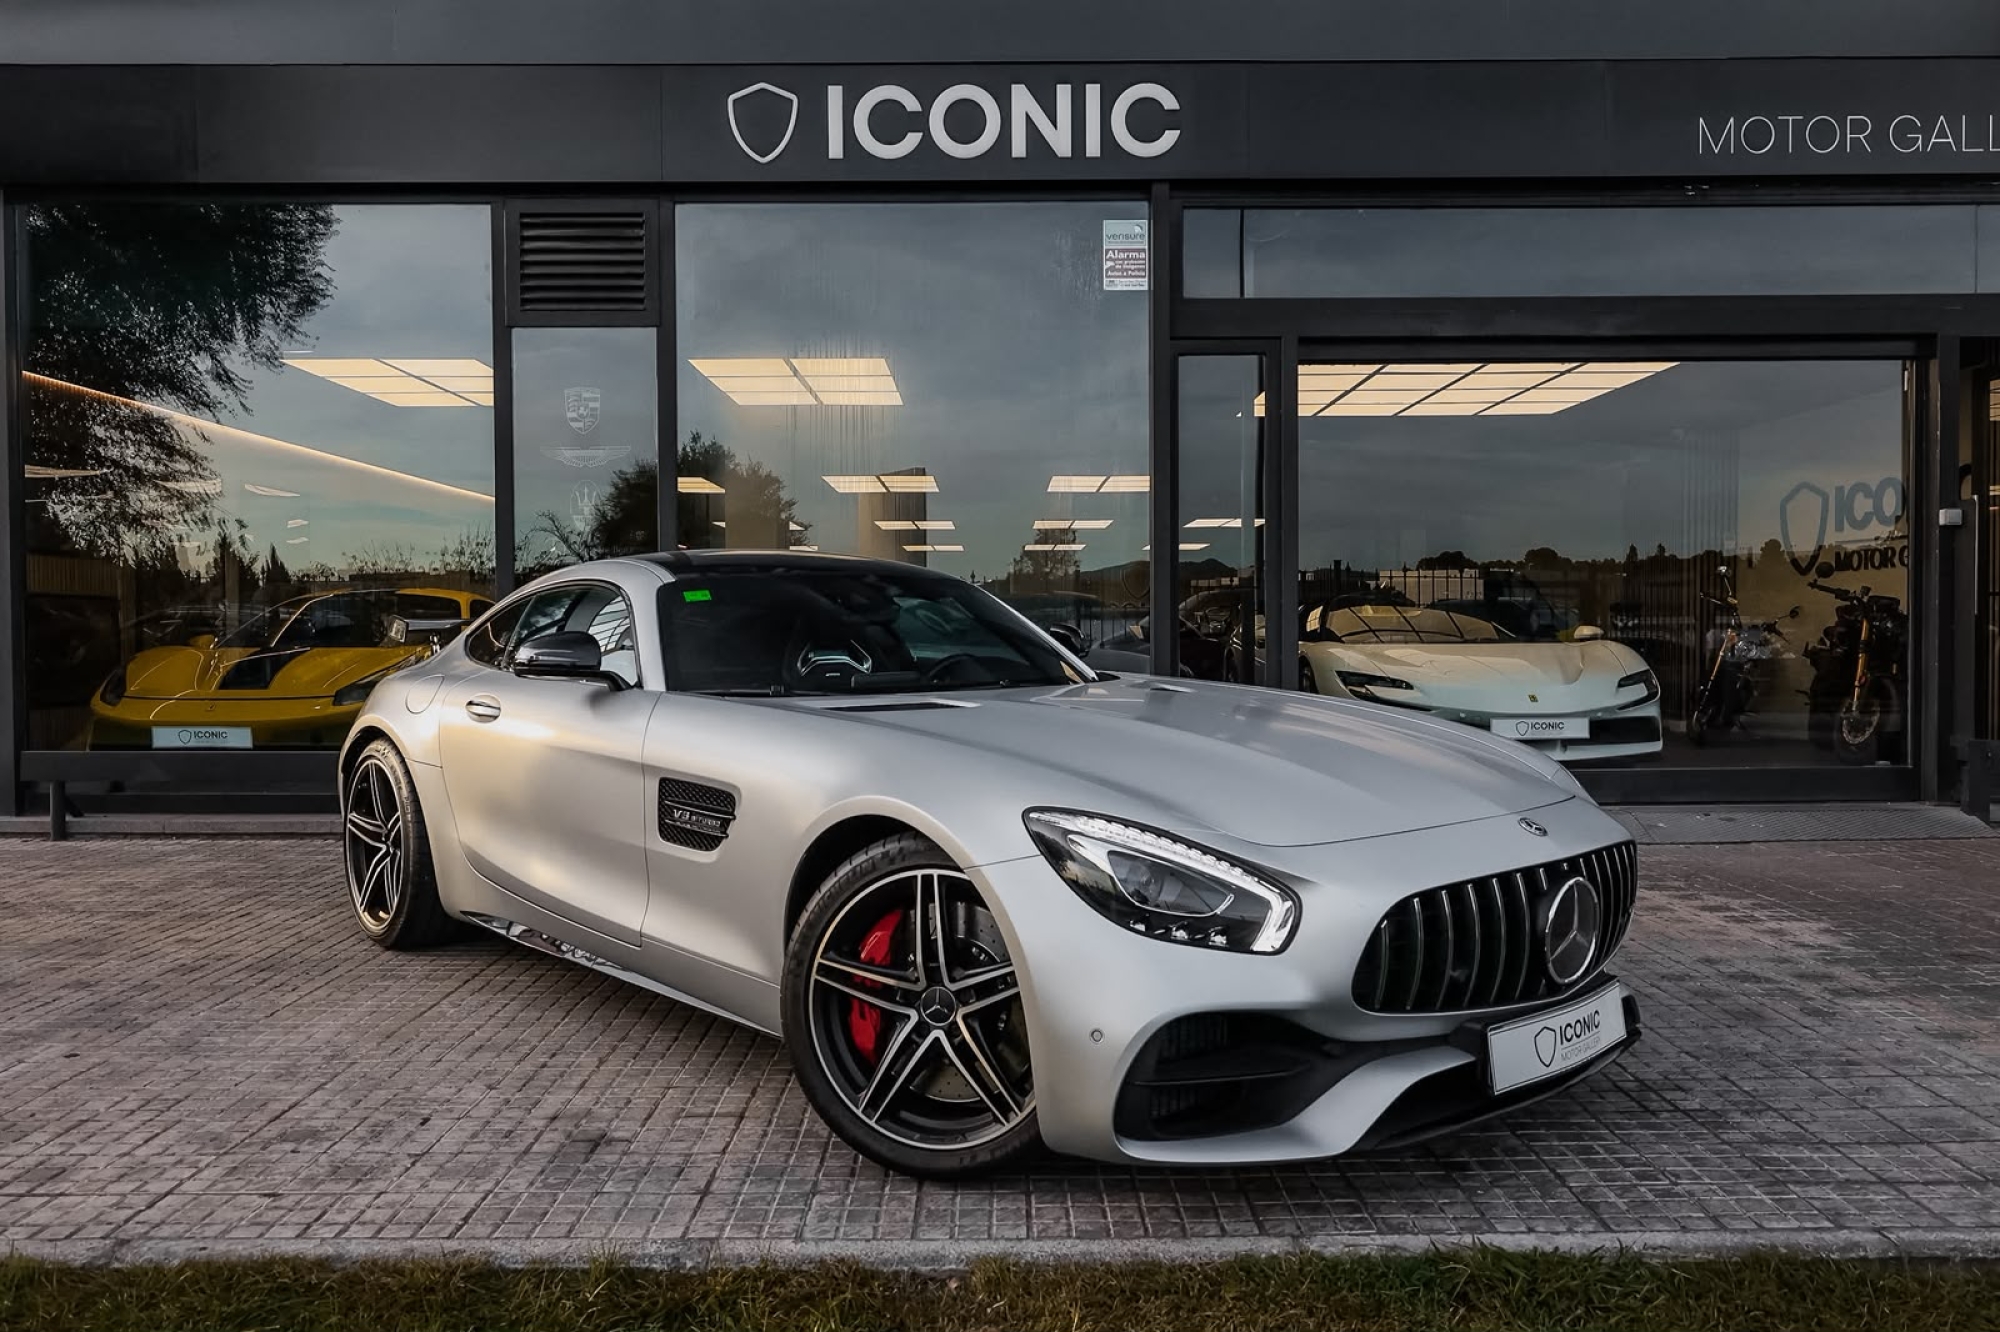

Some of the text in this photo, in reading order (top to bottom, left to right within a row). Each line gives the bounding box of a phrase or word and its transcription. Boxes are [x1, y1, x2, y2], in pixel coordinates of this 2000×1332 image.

[827, 83, 1181, 160] ICONIC
[1699, 114, 2000, 154] MOTOR GALL
[1106, 249, 1146, 260] Alarma
[1834, 546, 1898, 572] MOTOR
[194, 730, 228, 740] ICONIC
[1530, 721, 1564, 731] ICONIC
[673, 808, 691, 820] V8
[1559, 1009, 1600, 1046] ICONIC
